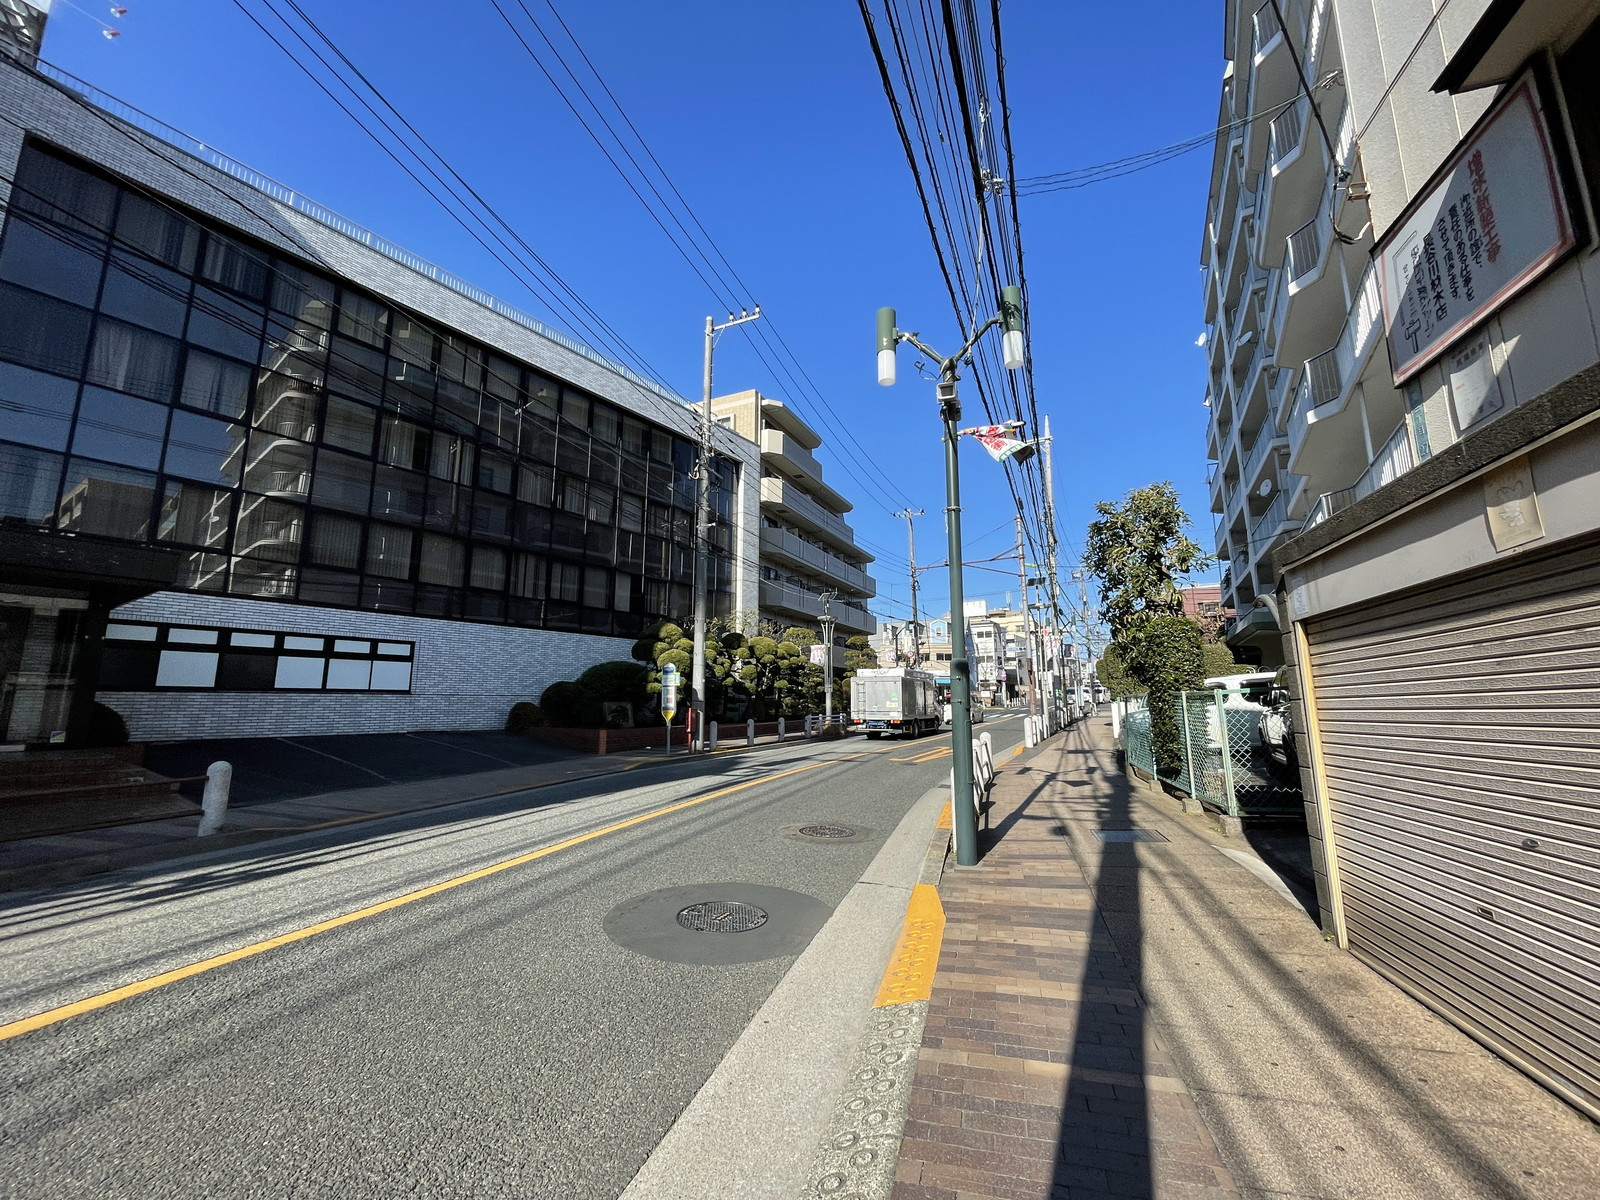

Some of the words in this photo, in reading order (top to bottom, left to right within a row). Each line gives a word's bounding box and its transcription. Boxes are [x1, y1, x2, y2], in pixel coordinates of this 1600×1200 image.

[1423, 230, 1447, 322] 長谷川材木店
[1447, 202, 1474, 301] 責任のある仕事を
